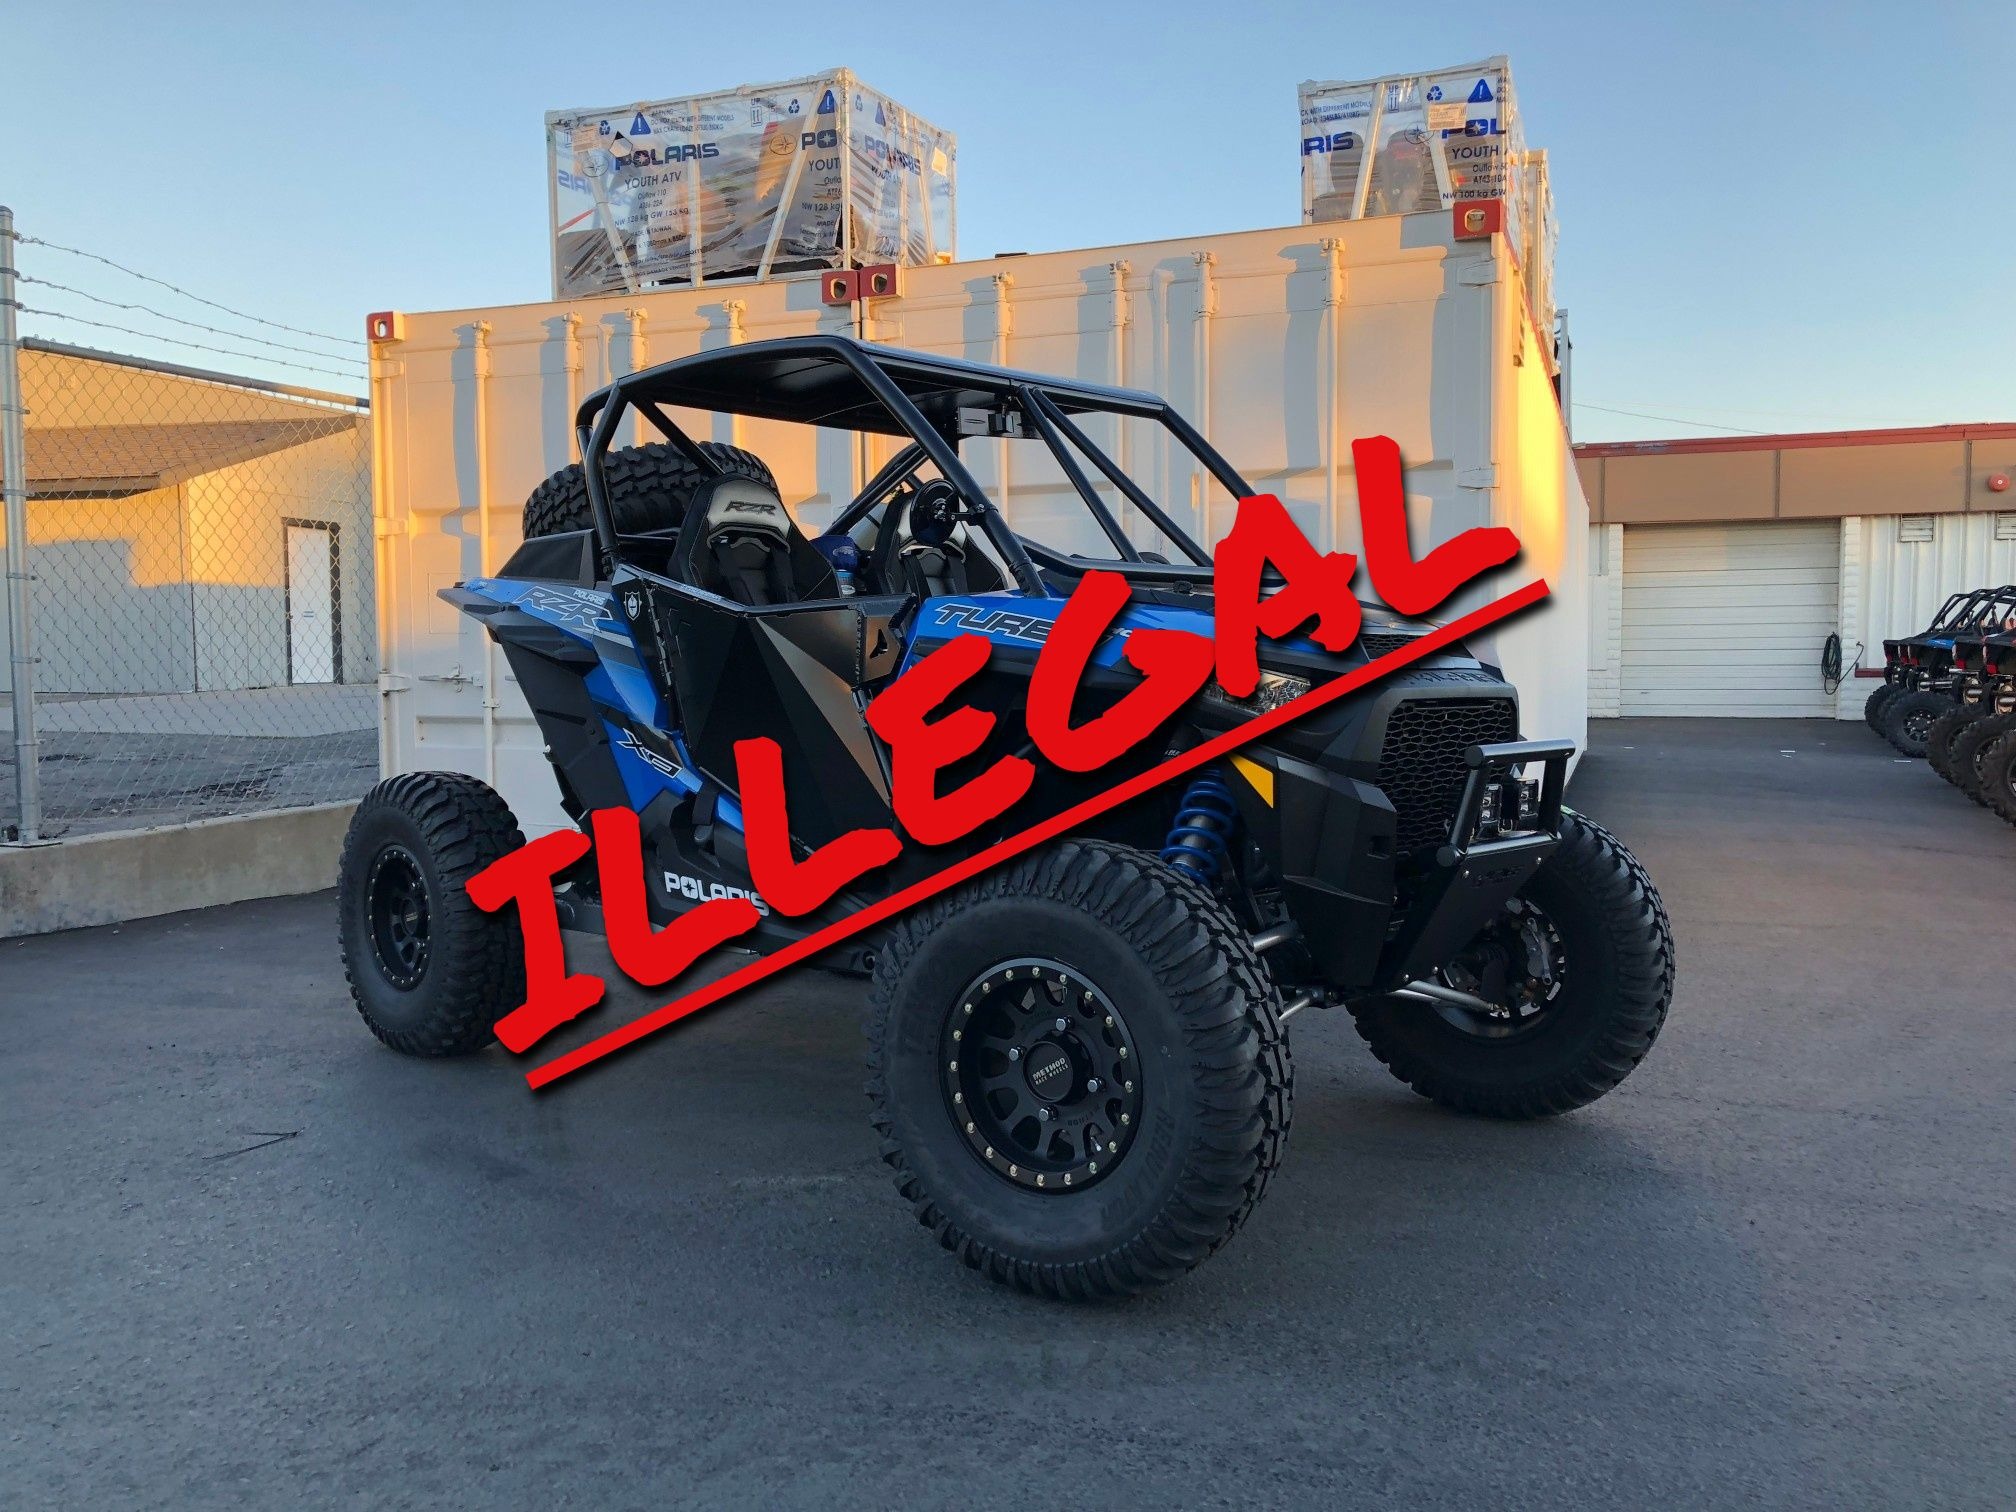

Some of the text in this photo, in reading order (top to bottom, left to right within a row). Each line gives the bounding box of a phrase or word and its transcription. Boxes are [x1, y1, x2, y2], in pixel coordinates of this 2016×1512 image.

[615, 142, 720, 171] POLARIS
[1452, 145, 1499, 160] YOUTH
[808, 158, 842, 172] YOUT
[624, 171, 682, 189] YOUTH ATV
[1460, 191, 1475, 199] 100
[573, 588, 606, 605] POLARIS
[512, 585, 614, 632] RZR
[1033, 1057, 1066, 1081] METHOD
